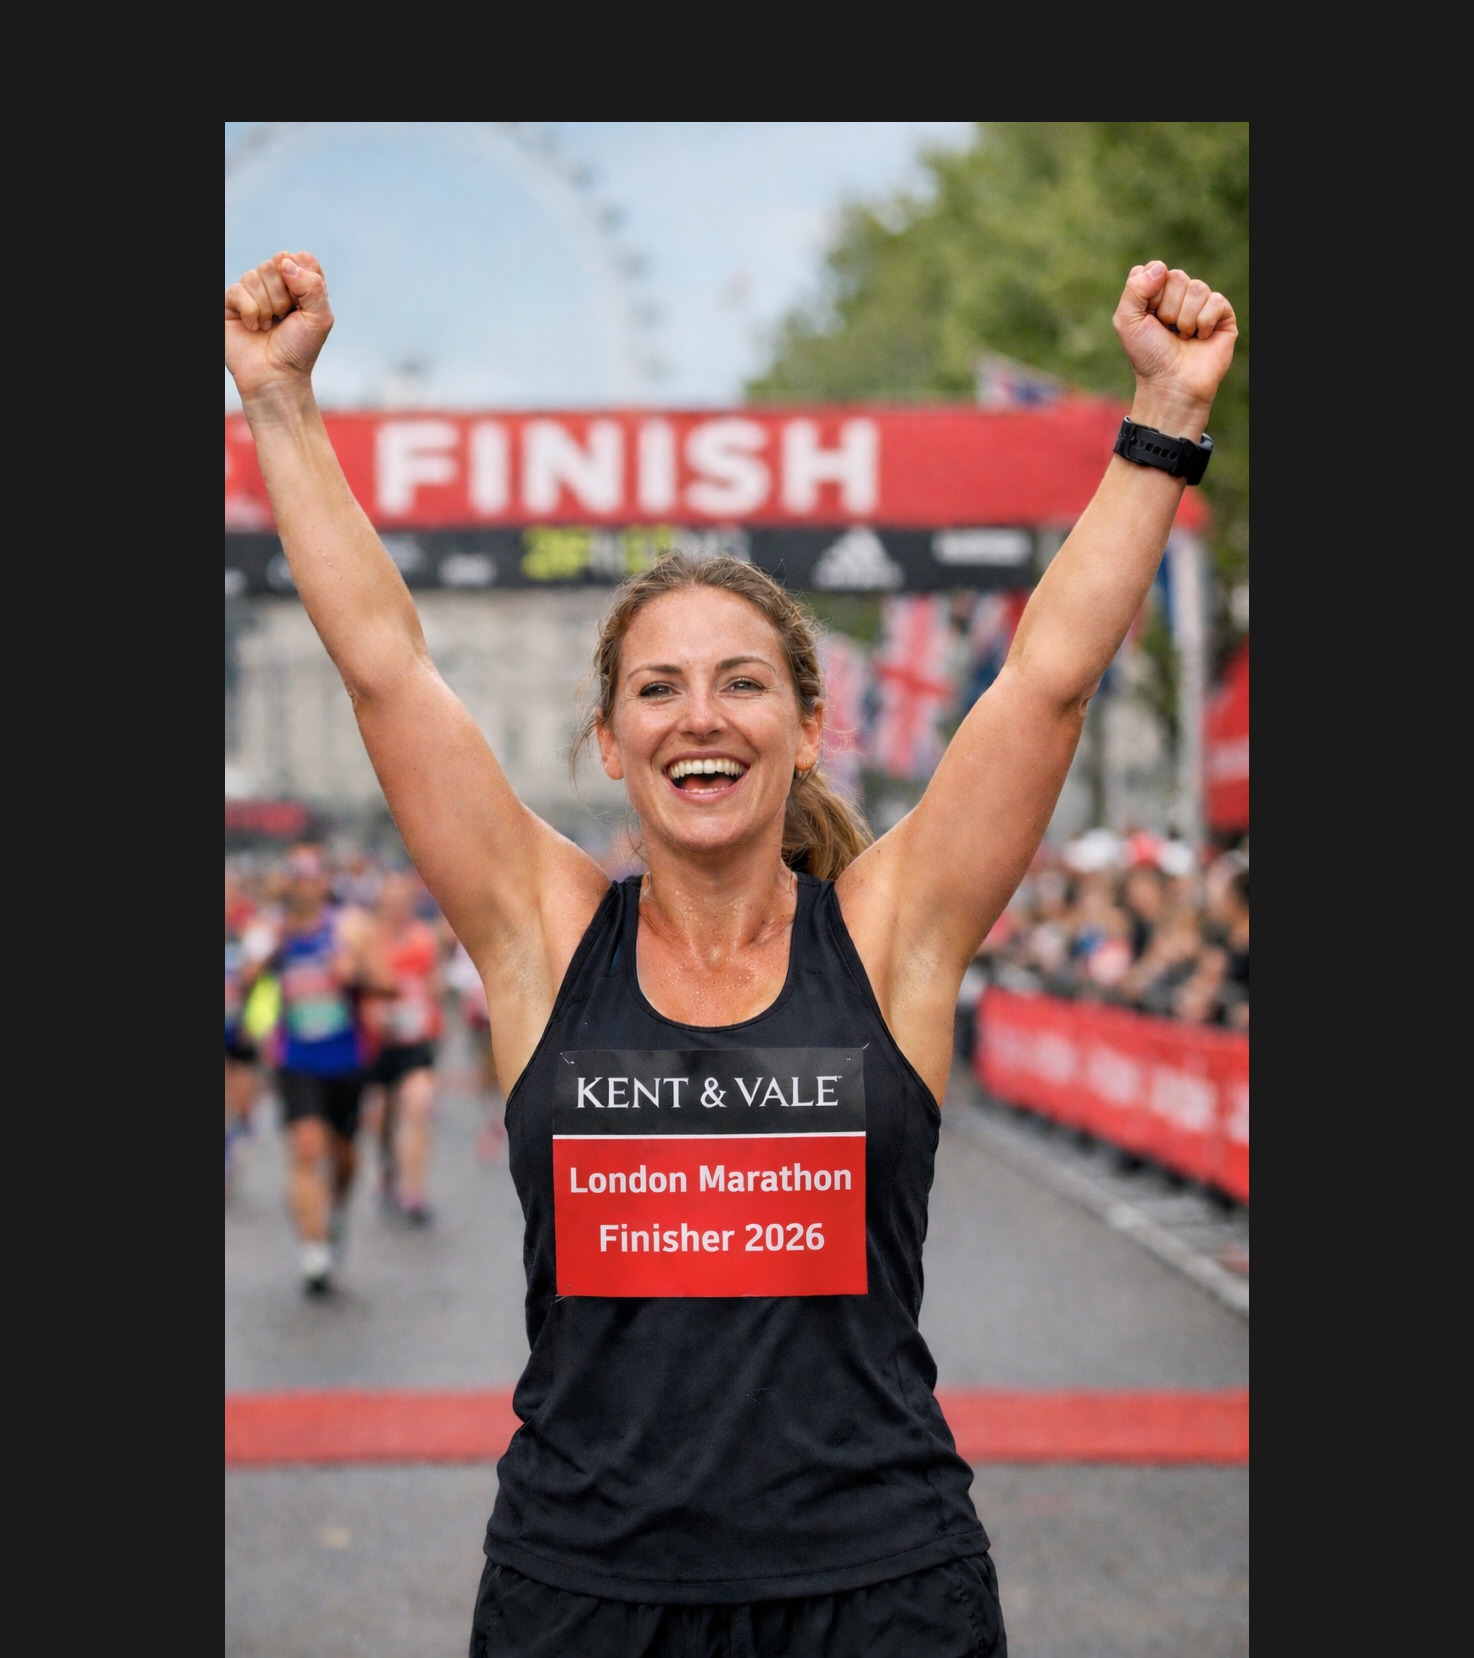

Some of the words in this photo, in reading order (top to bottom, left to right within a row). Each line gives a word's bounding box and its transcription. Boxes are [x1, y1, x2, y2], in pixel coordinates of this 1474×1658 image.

[374, 419, 880, 516] FINISH
[576, 1076, 689, 1109] KENT
[700, 1076, 727, 1109] &
[734, 1075, 839, 1108] VALE
[569, 1164, 688, 1194] London
[699, 1162, 852, 1193] Marathon
[599, 1222, 735, 1253] Finisher
[744, 1222, 825, 1252] 2026
